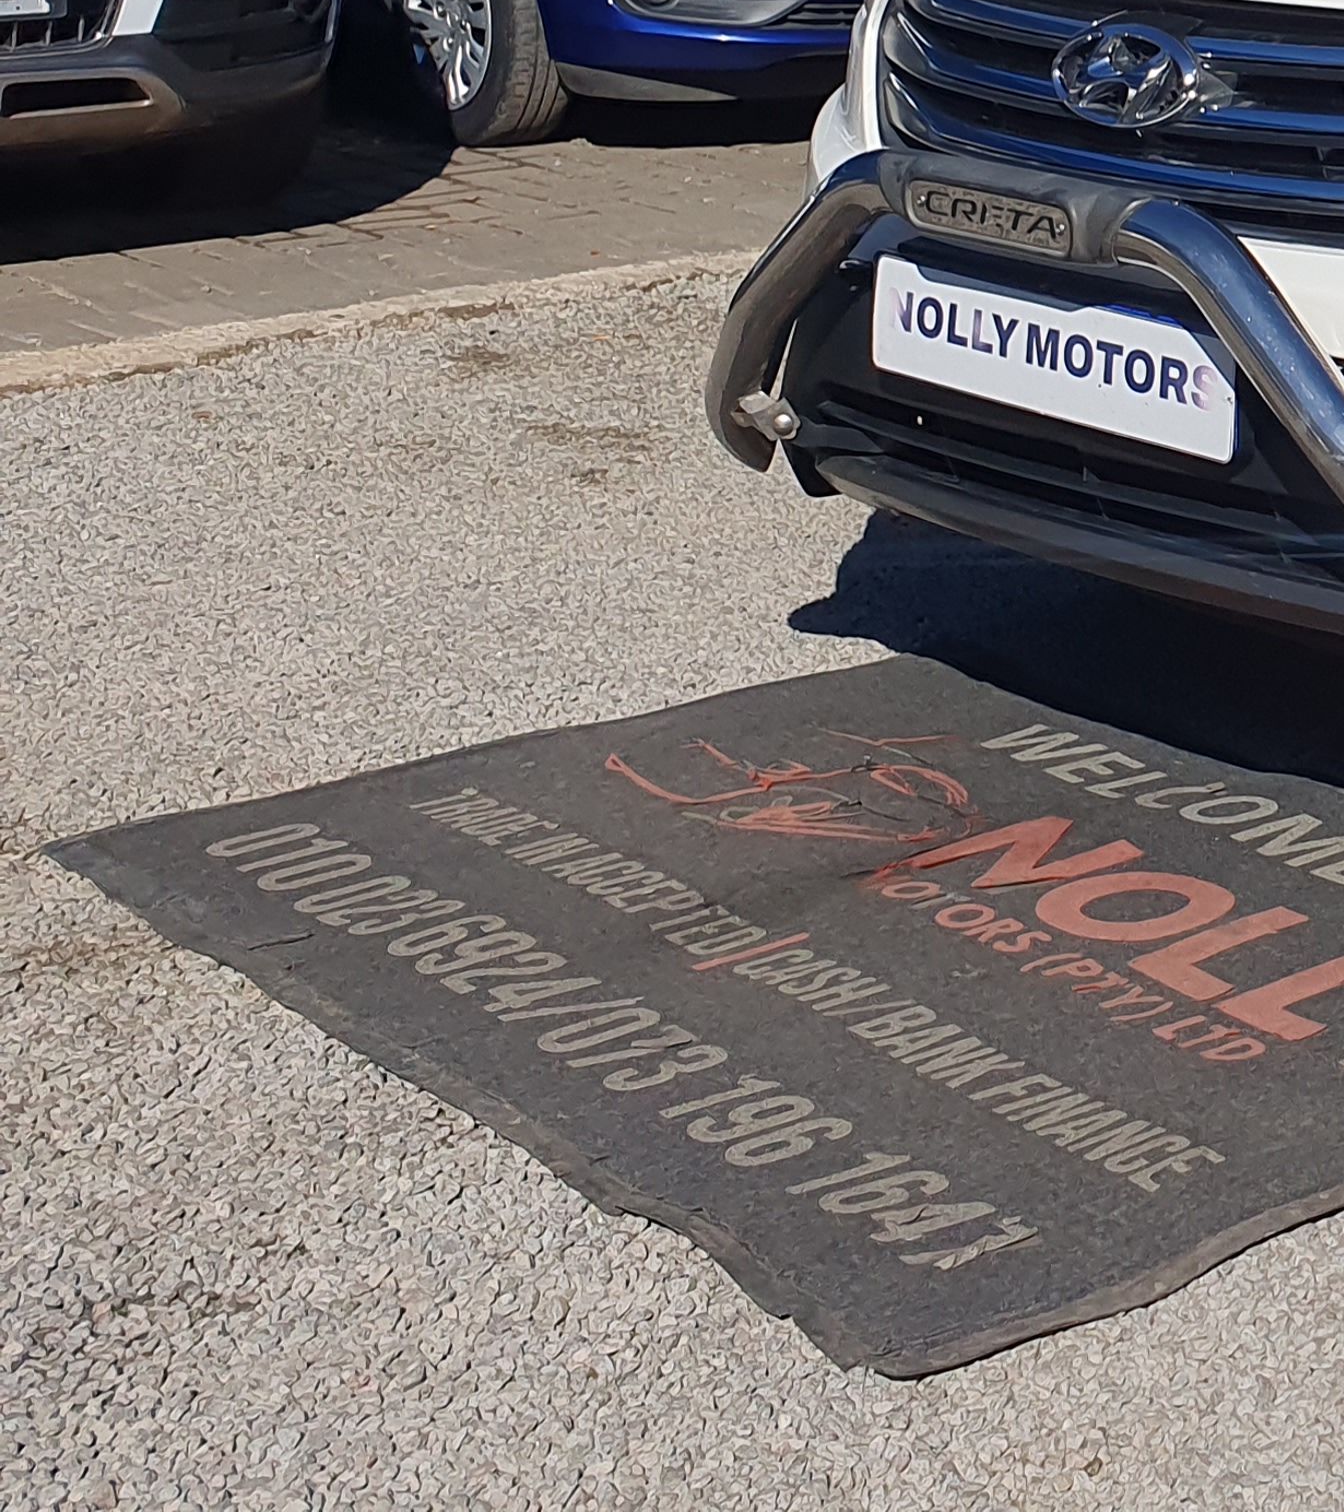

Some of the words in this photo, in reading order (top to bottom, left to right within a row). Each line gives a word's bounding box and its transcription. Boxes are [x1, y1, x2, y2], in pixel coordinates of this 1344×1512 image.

[926, 190, 1056, 239] CRETA
[892, 287, 1019, 358] NOLLY
[1025, 322, 1219, 411] MOTORS
[206, 823, 372, 891] 010
[659, 1074, 853, 1167] 196
[785, 1152, 1040, 1270] 1647
[410, 787, 560, 846] TRADE
[505, 832, 600, 865] IN
[967, 1073, 1225, 1193] FINANCE
[858, 876, 1053, 953] OTORS
[1020, 952, 1173, 1022] (PTY)
[1152, 1015, 1266, 1060] LTD
